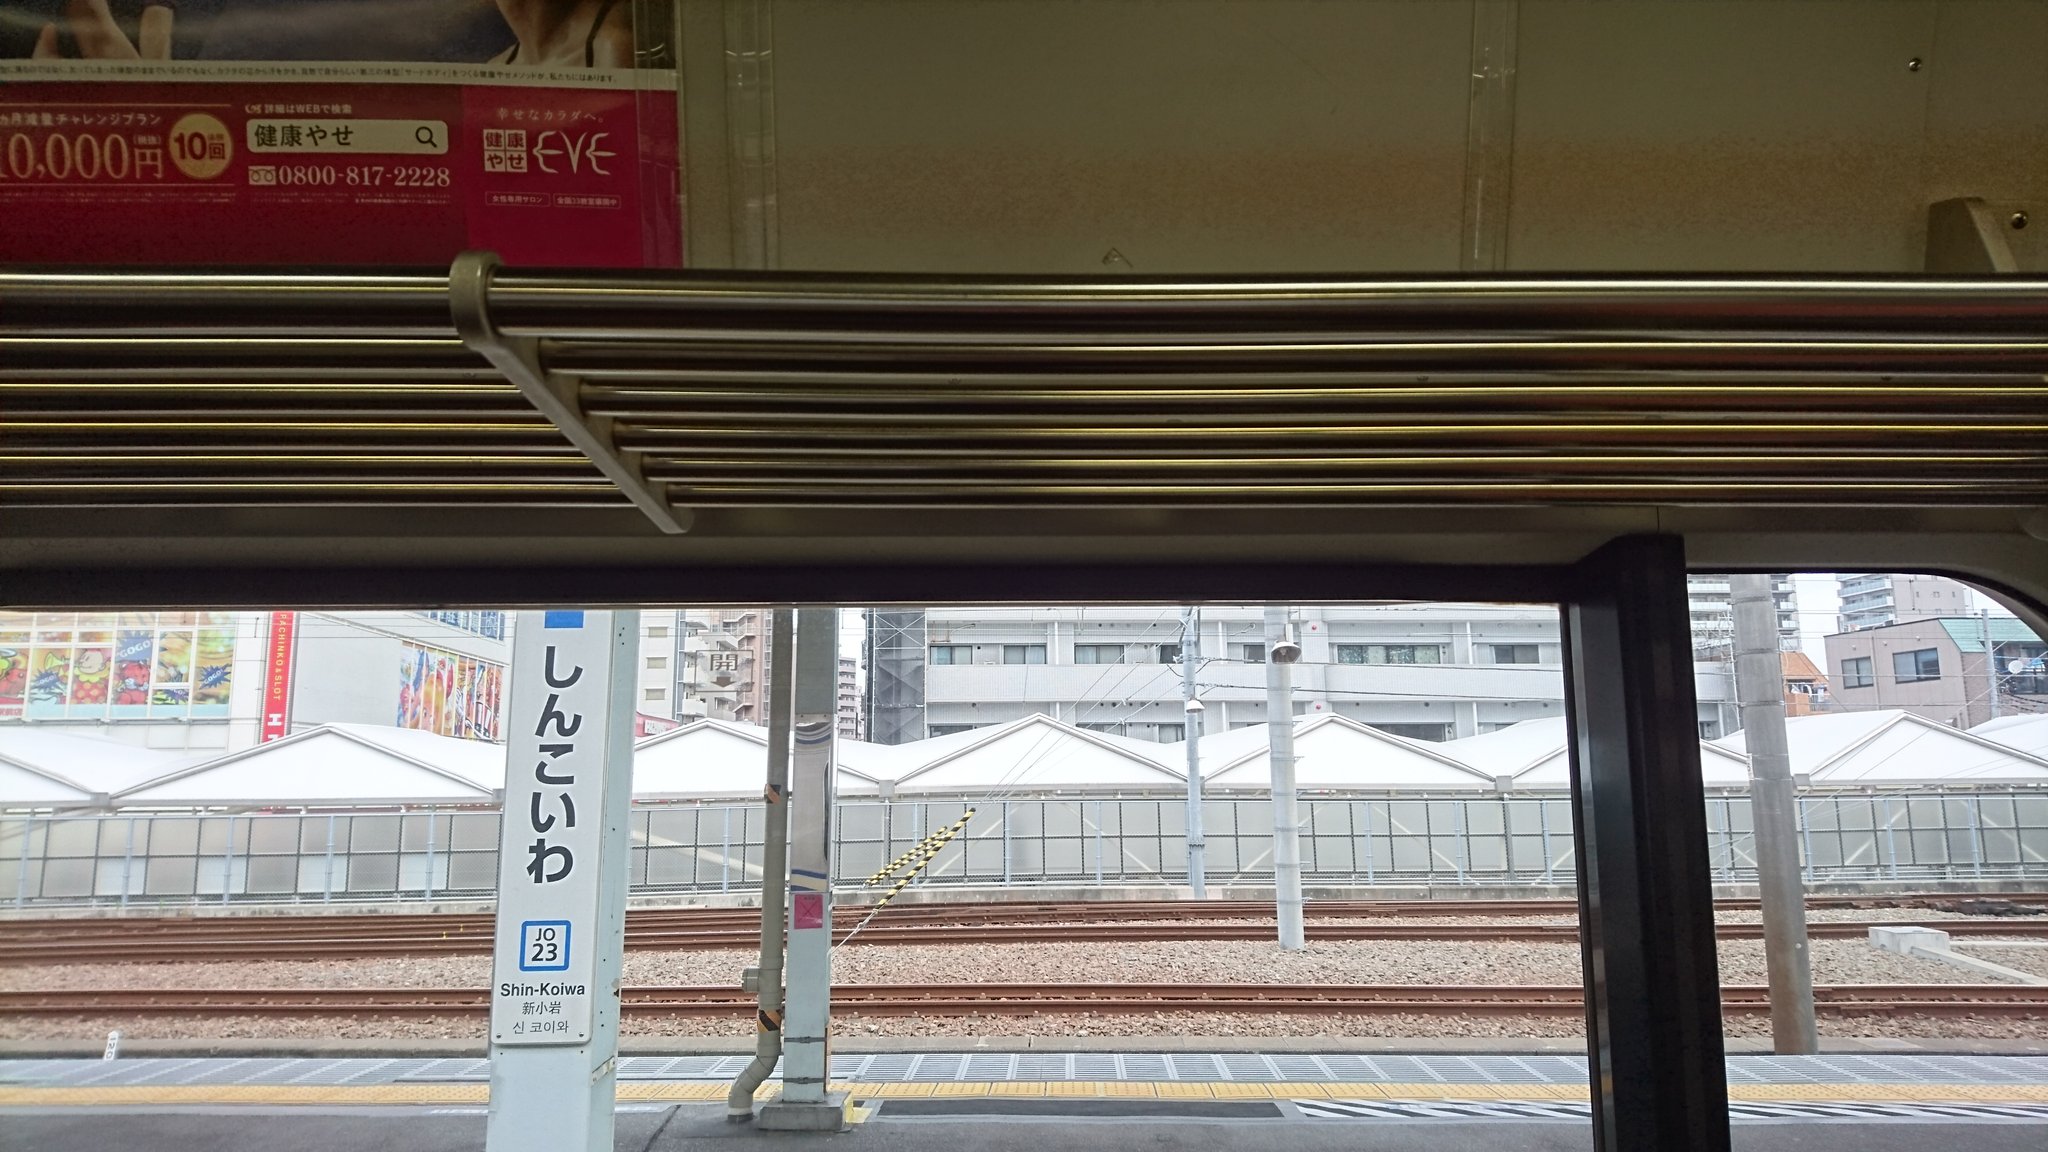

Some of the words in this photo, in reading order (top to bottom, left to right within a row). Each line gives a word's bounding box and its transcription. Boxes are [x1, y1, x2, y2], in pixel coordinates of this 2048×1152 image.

[496, 107, 604, 123] 幸せなカラダへ。
[254, 123, 354, 148] 健康やせ
[484, 130, 526, 149] 健康
[532, 129, 617, 175] EVE
[486, 153, 526, 171] やせ
[278, 165, 450, 187] 0800-817-2228
[710, 653, 738, 672] 開
[526, 645, 583, 884] しんこいわ
[535, 927, 556, 942] JO
[531, 942, 558, 962] 23
[500, 982, 585, 997] Shin-Koiwa
[522, 1001, 562, 1015] 新小岩
[512, 1020, 525, 1035] 신
[529, 1020, 569, 1034] 코이와
